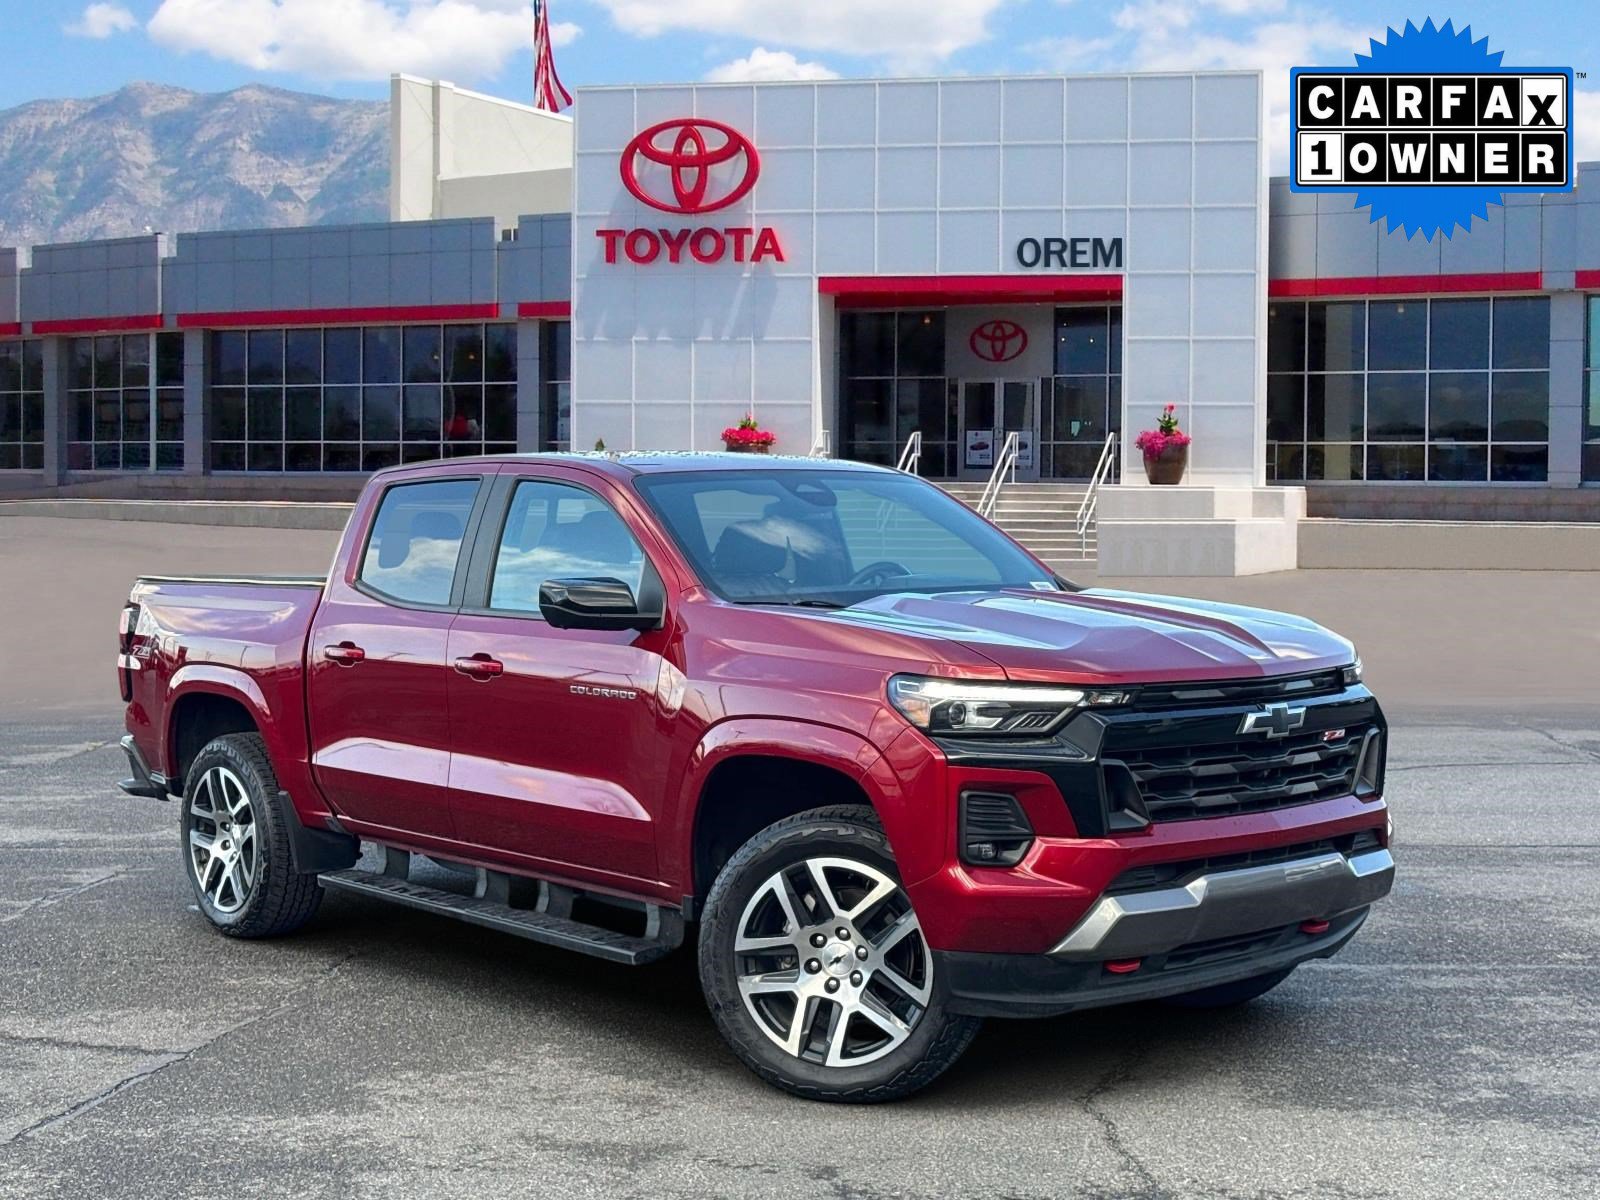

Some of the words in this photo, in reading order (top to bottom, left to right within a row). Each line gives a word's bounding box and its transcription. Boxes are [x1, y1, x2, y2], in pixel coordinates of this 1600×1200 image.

[595, 227, 785, 265] TOYOTA
[1016, 237, 1123, 268] OREM
[569, 685, 637, 700] COLORADO
